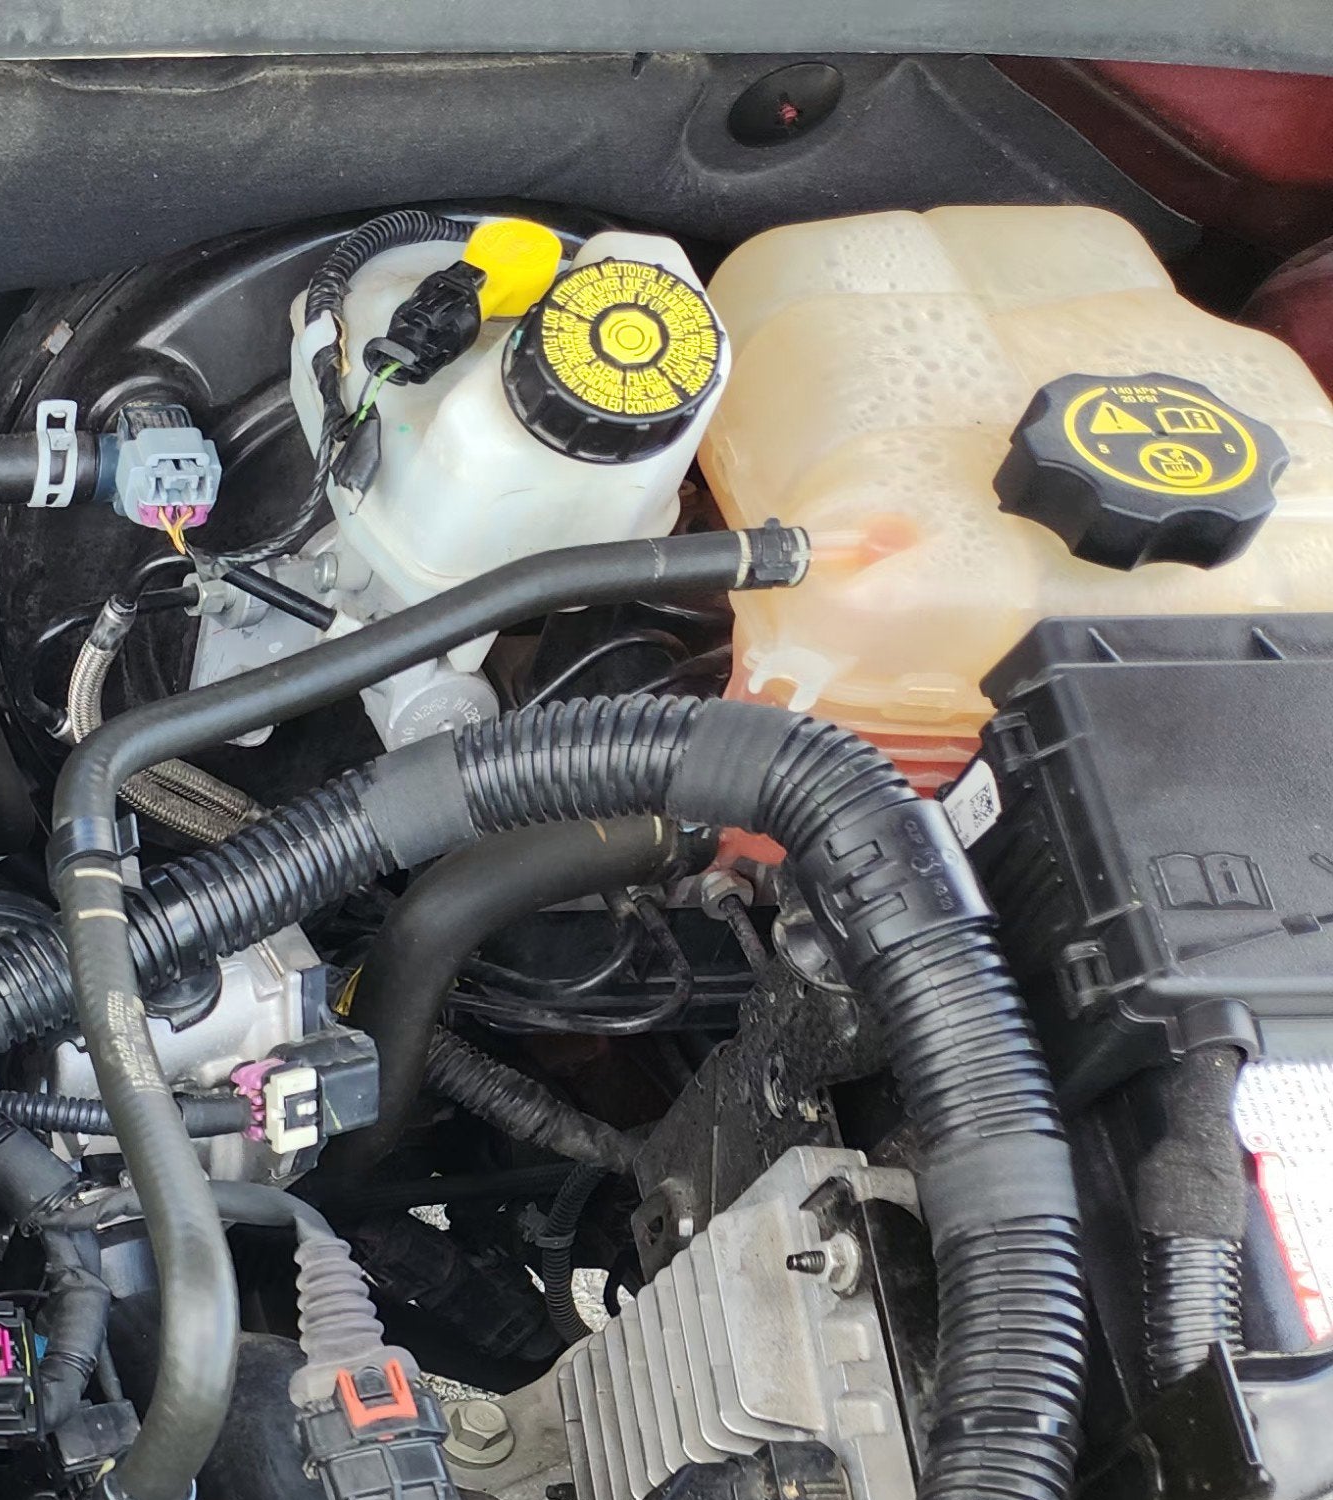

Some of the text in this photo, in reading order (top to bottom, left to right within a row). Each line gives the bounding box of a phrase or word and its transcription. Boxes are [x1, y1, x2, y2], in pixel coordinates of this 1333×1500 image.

[551, 265, 602, 306] ATTENTION
[600, 262, 659, 282] NETTOYER
[658, 274, 676, 289] LE
[673, 283, 713, 327] BOUCHON
[623, 277, 645, 292] QUE
[644, 281, 662, 297] DU
[543, 309, 560, 329] DOT
[542, 337, 563, 365] FLUID
[558, 313, 671, 399] CAP BEFORE REMOVING USE ONLY
[553, 362, 582, 389] FROM
[591, 360, 624, 385] CLEAN
[626, 367, 661, 386] FILLER
[574, 384, 587, 396] A
[582, 388, 623, 413] SEALED
[1110, 386, 1158, 395] 140 kPa
[1121, 395, 1137, 403] 20
[624, 392, 684, 414] CONTAINER
